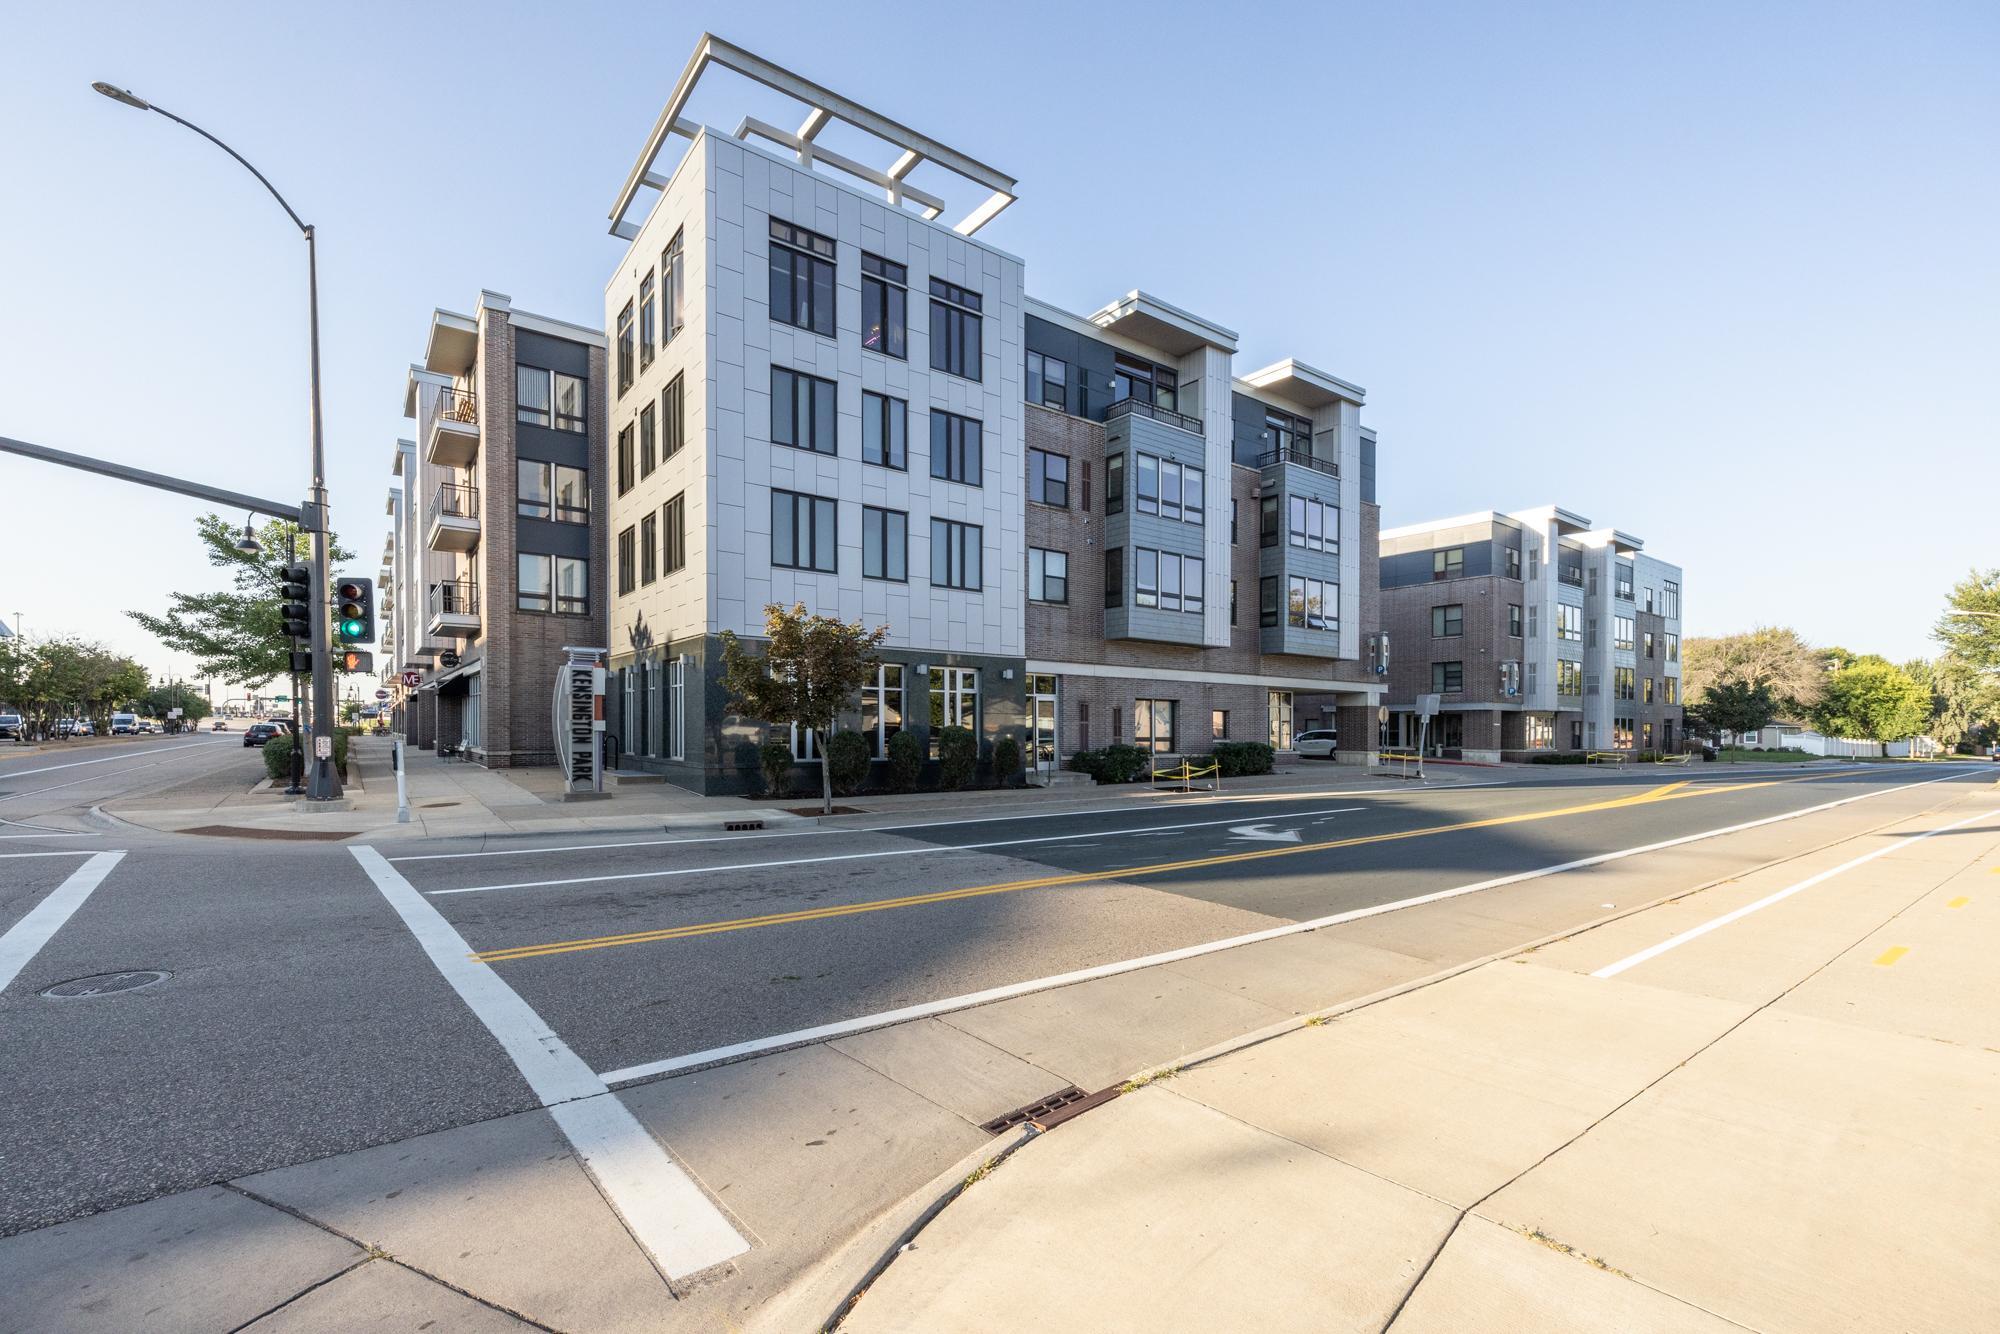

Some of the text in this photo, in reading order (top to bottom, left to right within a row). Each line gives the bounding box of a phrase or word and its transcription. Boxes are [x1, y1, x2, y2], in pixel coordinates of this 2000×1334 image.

[403, 674, 419, 685] ME
[572, 669, 592, 782] KENSINGTON PARK
